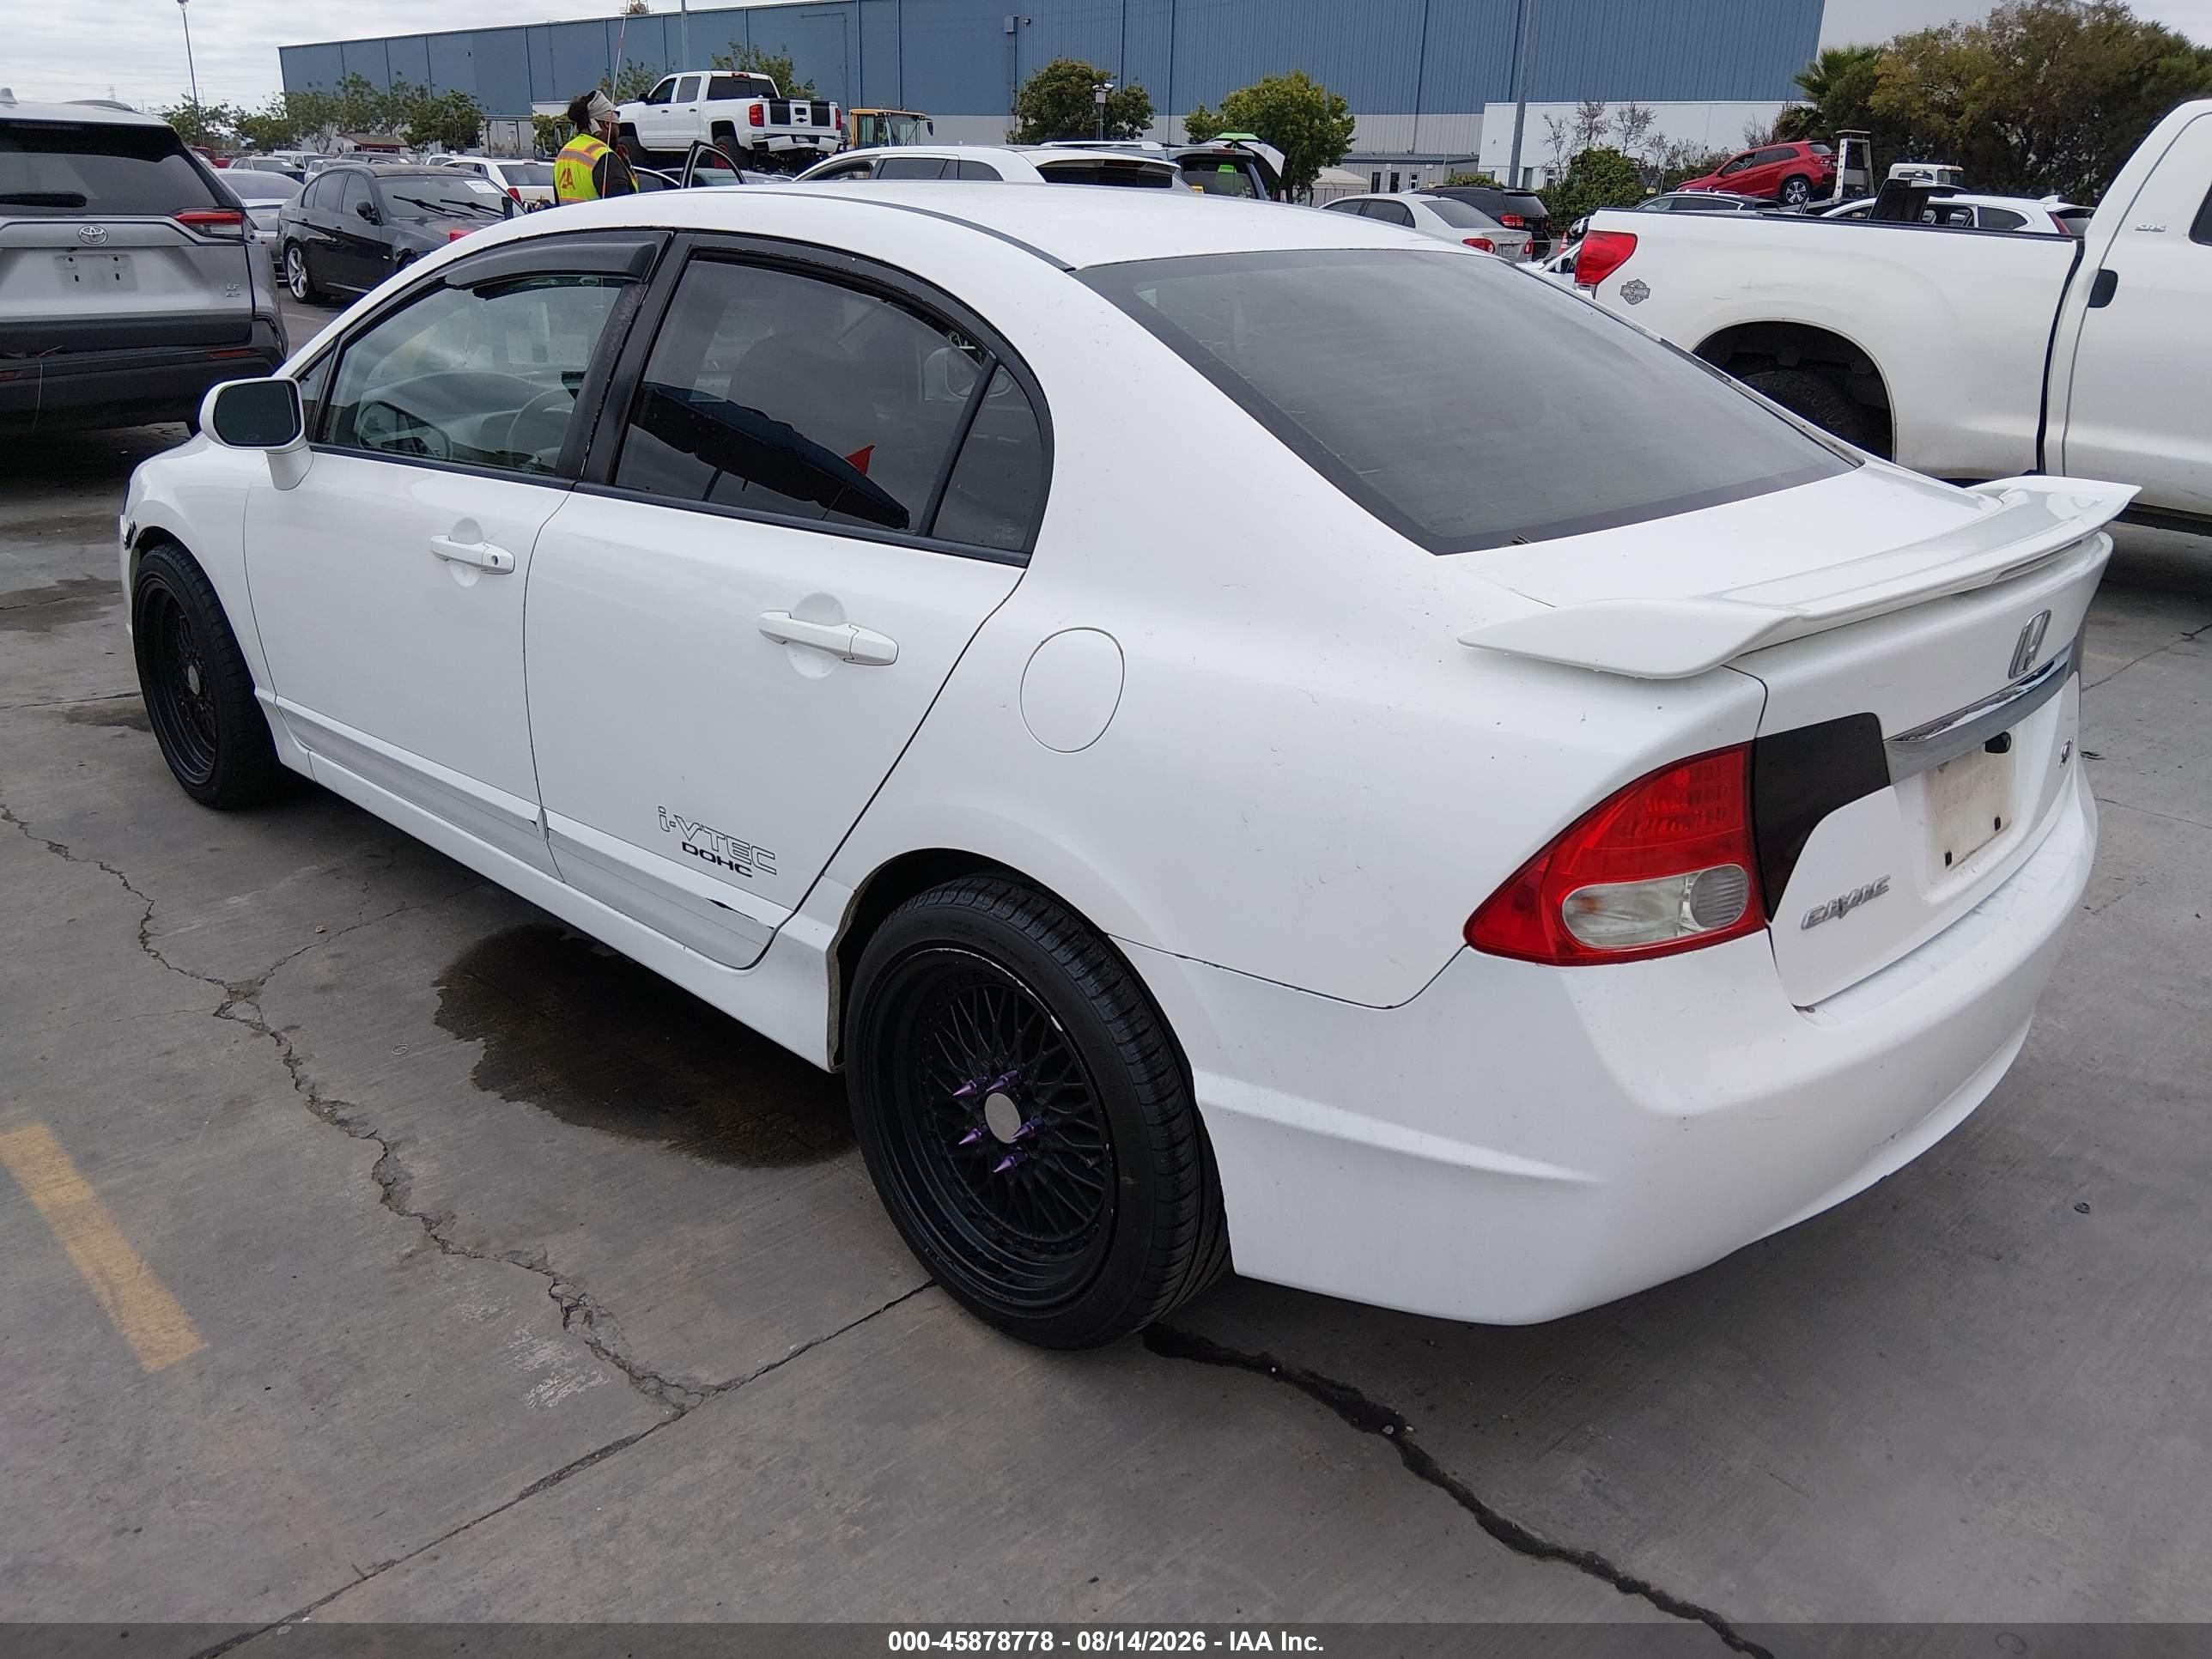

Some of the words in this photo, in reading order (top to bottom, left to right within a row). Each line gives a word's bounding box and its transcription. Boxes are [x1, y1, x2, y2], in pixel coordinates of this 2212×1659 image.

[658, 805, 777, 876] i-VTEC
[681, 841, 753, 878] DOHC
[1801, 874, 1891, 930] CIVIC
